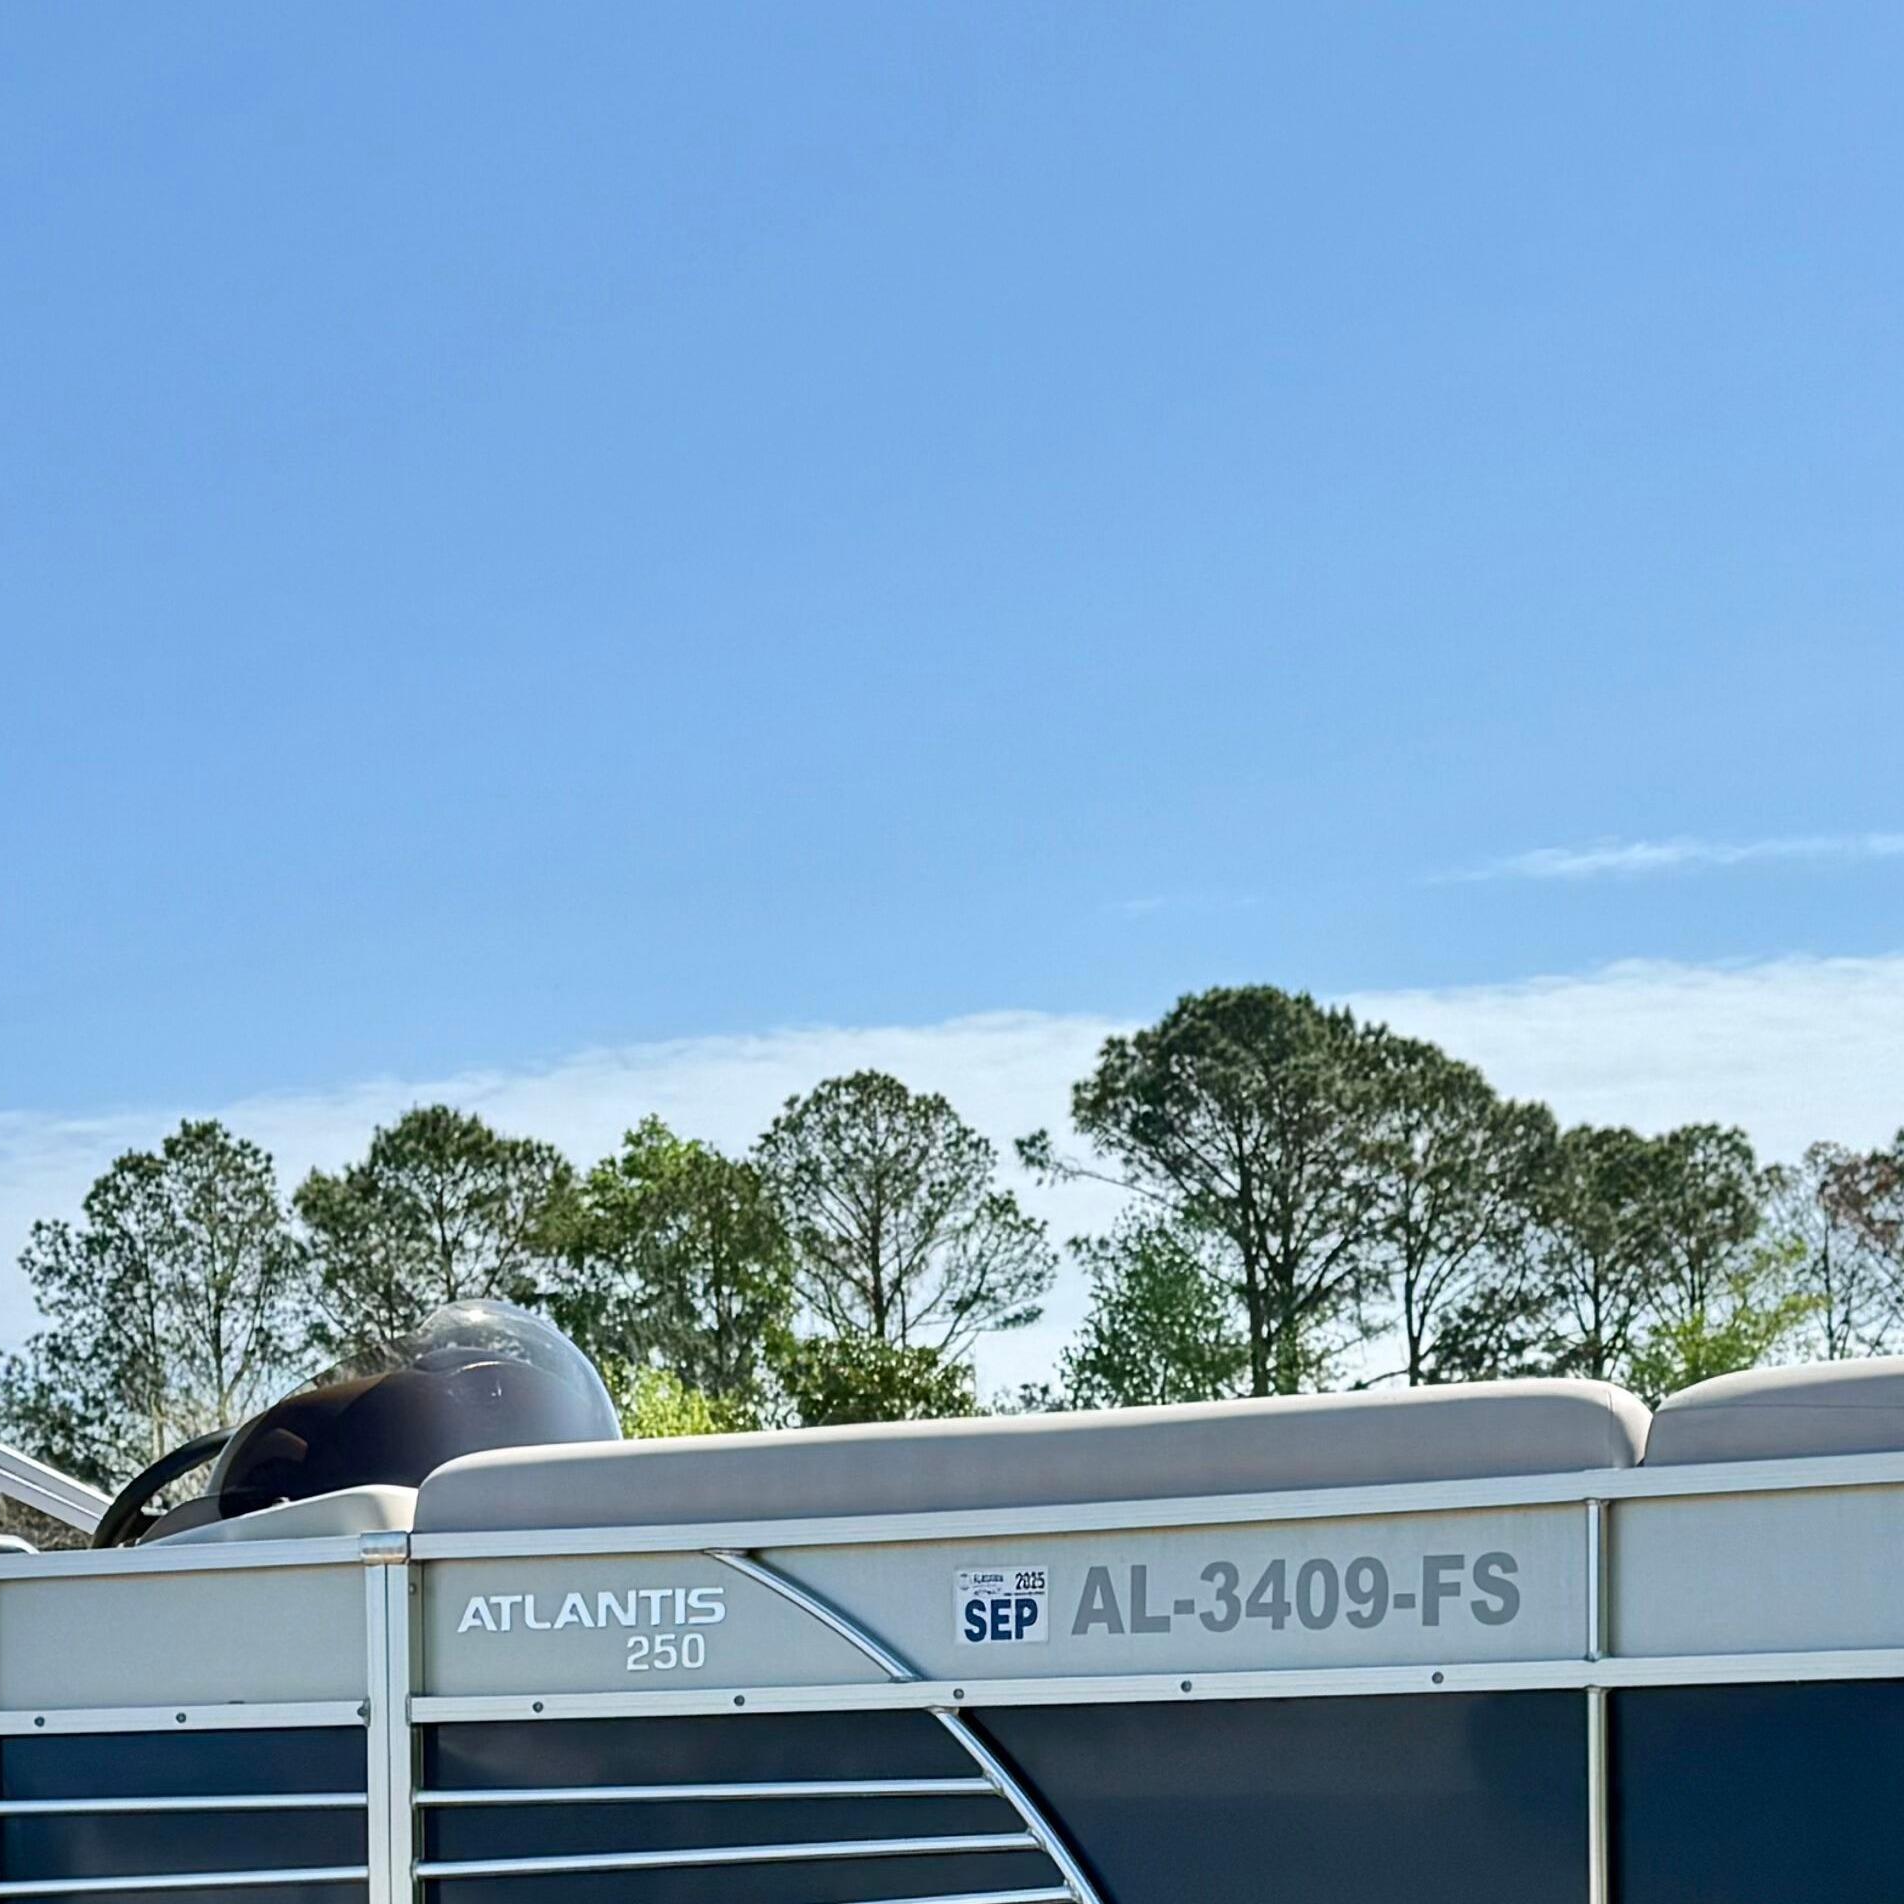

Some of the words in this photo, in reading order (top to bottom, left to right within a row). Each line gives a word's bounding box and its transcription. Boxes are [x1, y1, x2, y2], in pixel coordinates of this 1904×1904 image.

[457, 1587, 726, 1633] ATLANTIS
[1071, 1552, 1521, 1636] AL-3409-FS
[964, 1599, 1038, 1642] SEP
[626, 1633, 705, 1671] 250
